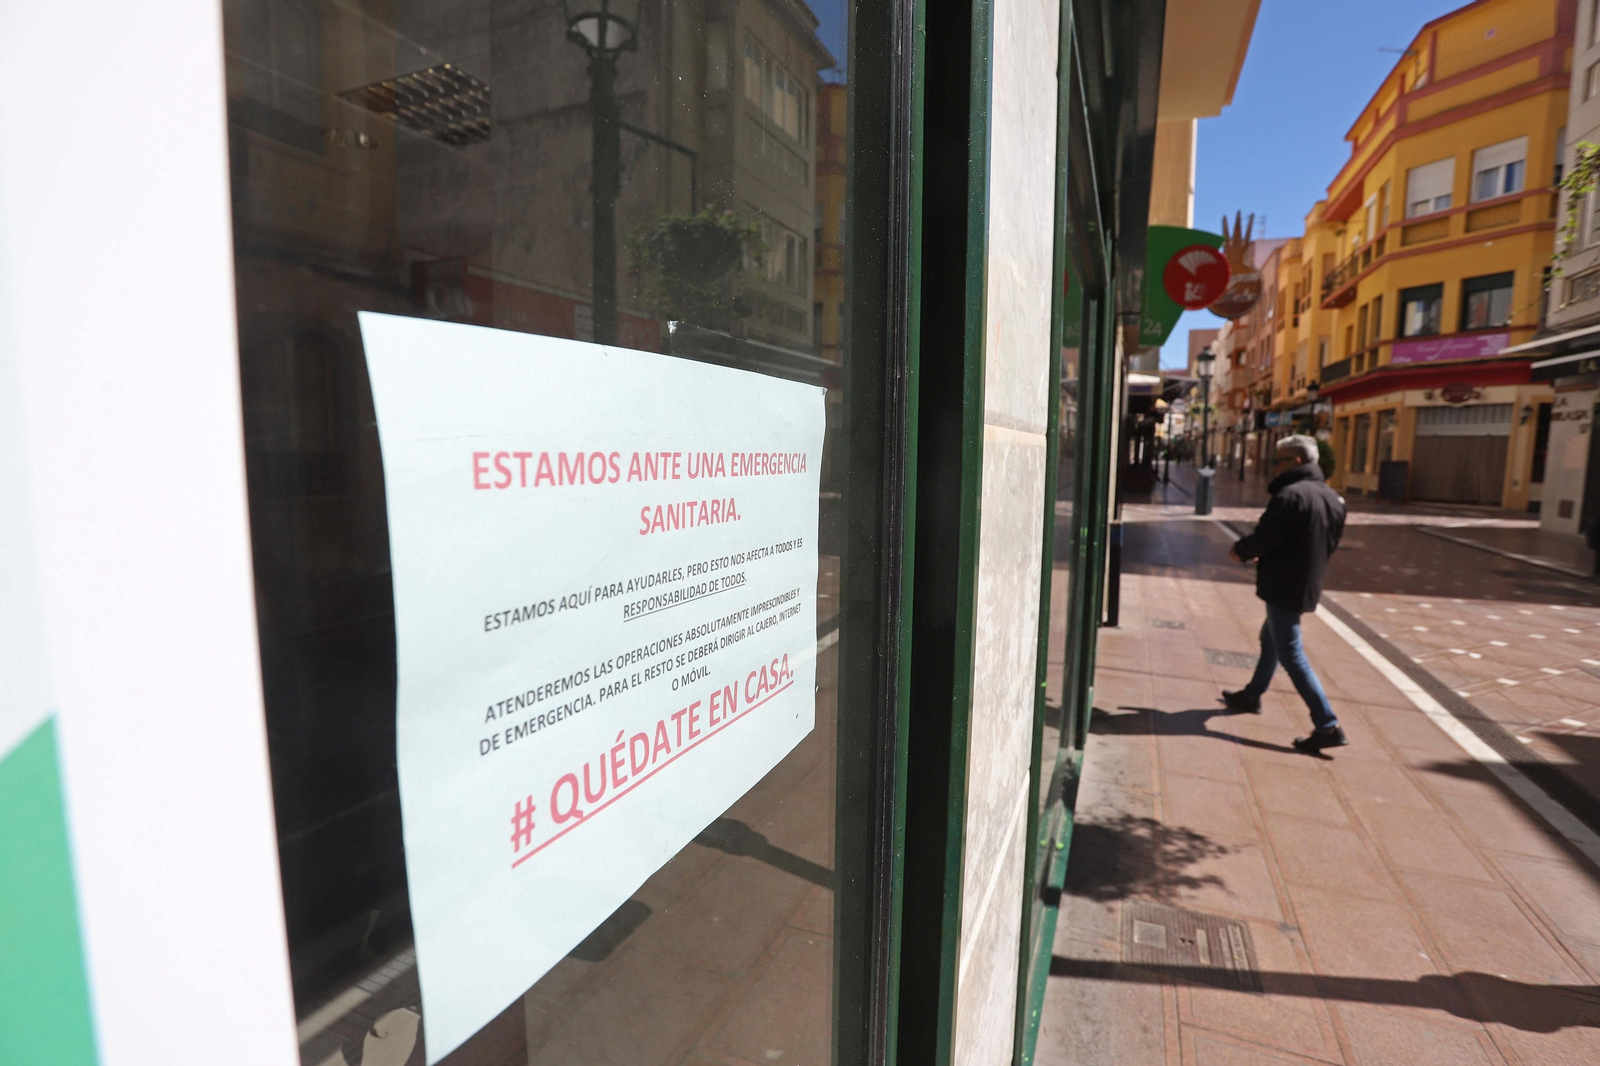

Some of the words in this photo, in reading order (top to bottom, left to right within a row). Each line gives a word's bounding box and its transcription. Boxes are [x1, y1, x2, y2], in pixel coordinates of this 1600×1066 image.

[472, 451, 621, 490] ESTAMOS
[627, 451, 681, 482] ANTE
[687, 452, 726, 479] UNA
[730, 452, 807, 477] EMERGENCIA
[639, 498, 741, 535] SANITARIA.
[484, 599, 555, 632] ESTAMOS
[558, 586, 592, 612] AQUÍ
[594, 582, 624, 602] PARA
[626, 567, 685, 593] AYUDARLES,
[687, 562, 709, 578] PERO
[710, 556, 729, 572] ESTO
[730, 552, 745, 566] NOS
[746, 547, 769, 562] AFECTA
[769, 546, 775, 556] A
[775, 540, 793, 554] TODOS
[793, 539, 797, 549] Y
[797, 538, 803, 548] ES
[623, 585, 707, 619] RESPONSABILIDAD
[708, 579, 719, 592] DE
[720, 571, 747, 589] TODOS.
[479, 733, 501, 756] DE
[505, 694, 597, 745] EMERGENCIA.
[599, 678, 629, 703] PARA
[631, 672, 642, 688] EL
[644, 658, 673, 681] RESTO
[675, 652, 686, 669] SE
[687, 637, 719, 663] DEBERÁ
[720, 625, 746, 647] DIRIGIR
[746, 621, 756, 637] AL
[755, 614, 779, 634] CAJERO,
[779, 602, 802, 623] INTERNET
[484, 668, 590, 724] ATENDEREMOS
[593, 659, 613, 679] LAS
[615, 633, 683, 670] OPERACIONES
[685, 607, 750, 643] ABSOLUTAMENTE
[750, 588, 796, 617] IMPRESCINDIBLES
[796, 587, 801, 597] Y
[671, 678, 679, 692] O
[681, 664, 711, 689] MÓVIL.
[510, 795, 536, 854] #
[551, 699, 701, 825] QUÉDATE
[709, 680, 739, 728] EN
[744, 652, 794, 705] CASA.
